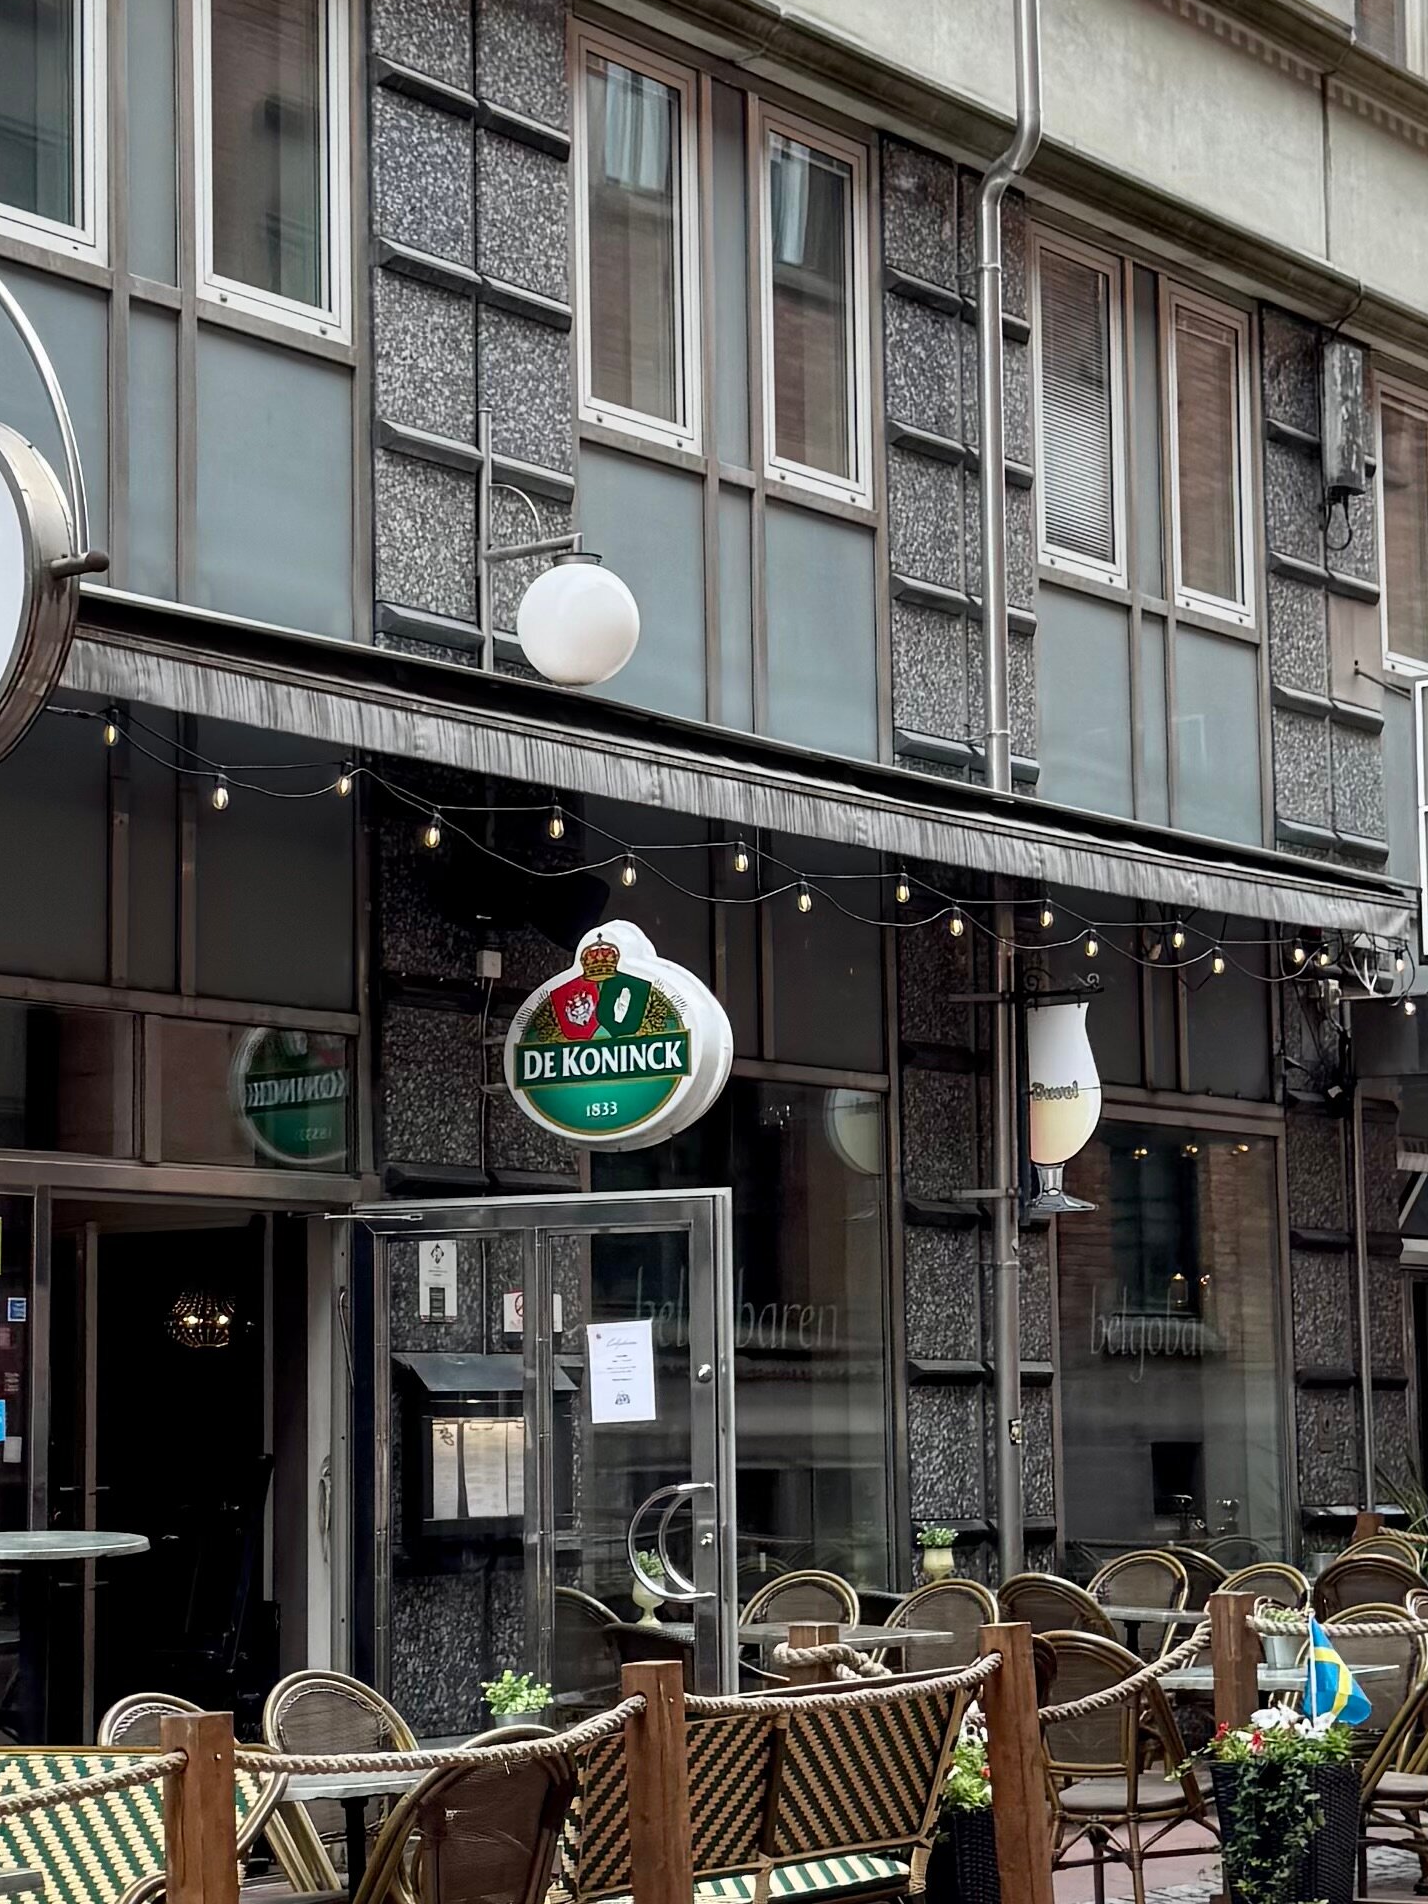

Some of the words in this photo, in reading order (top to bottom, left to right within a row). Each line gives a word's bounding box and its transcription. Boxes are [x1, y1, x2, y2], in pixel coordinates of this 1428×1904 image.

[523, 1049, 557, 1080] DE
[562, 1039, 683, 1077] KONINCK
[586, 1101, 618, 1118] 1833
[635, 1264, 838, 1349] belbaren
